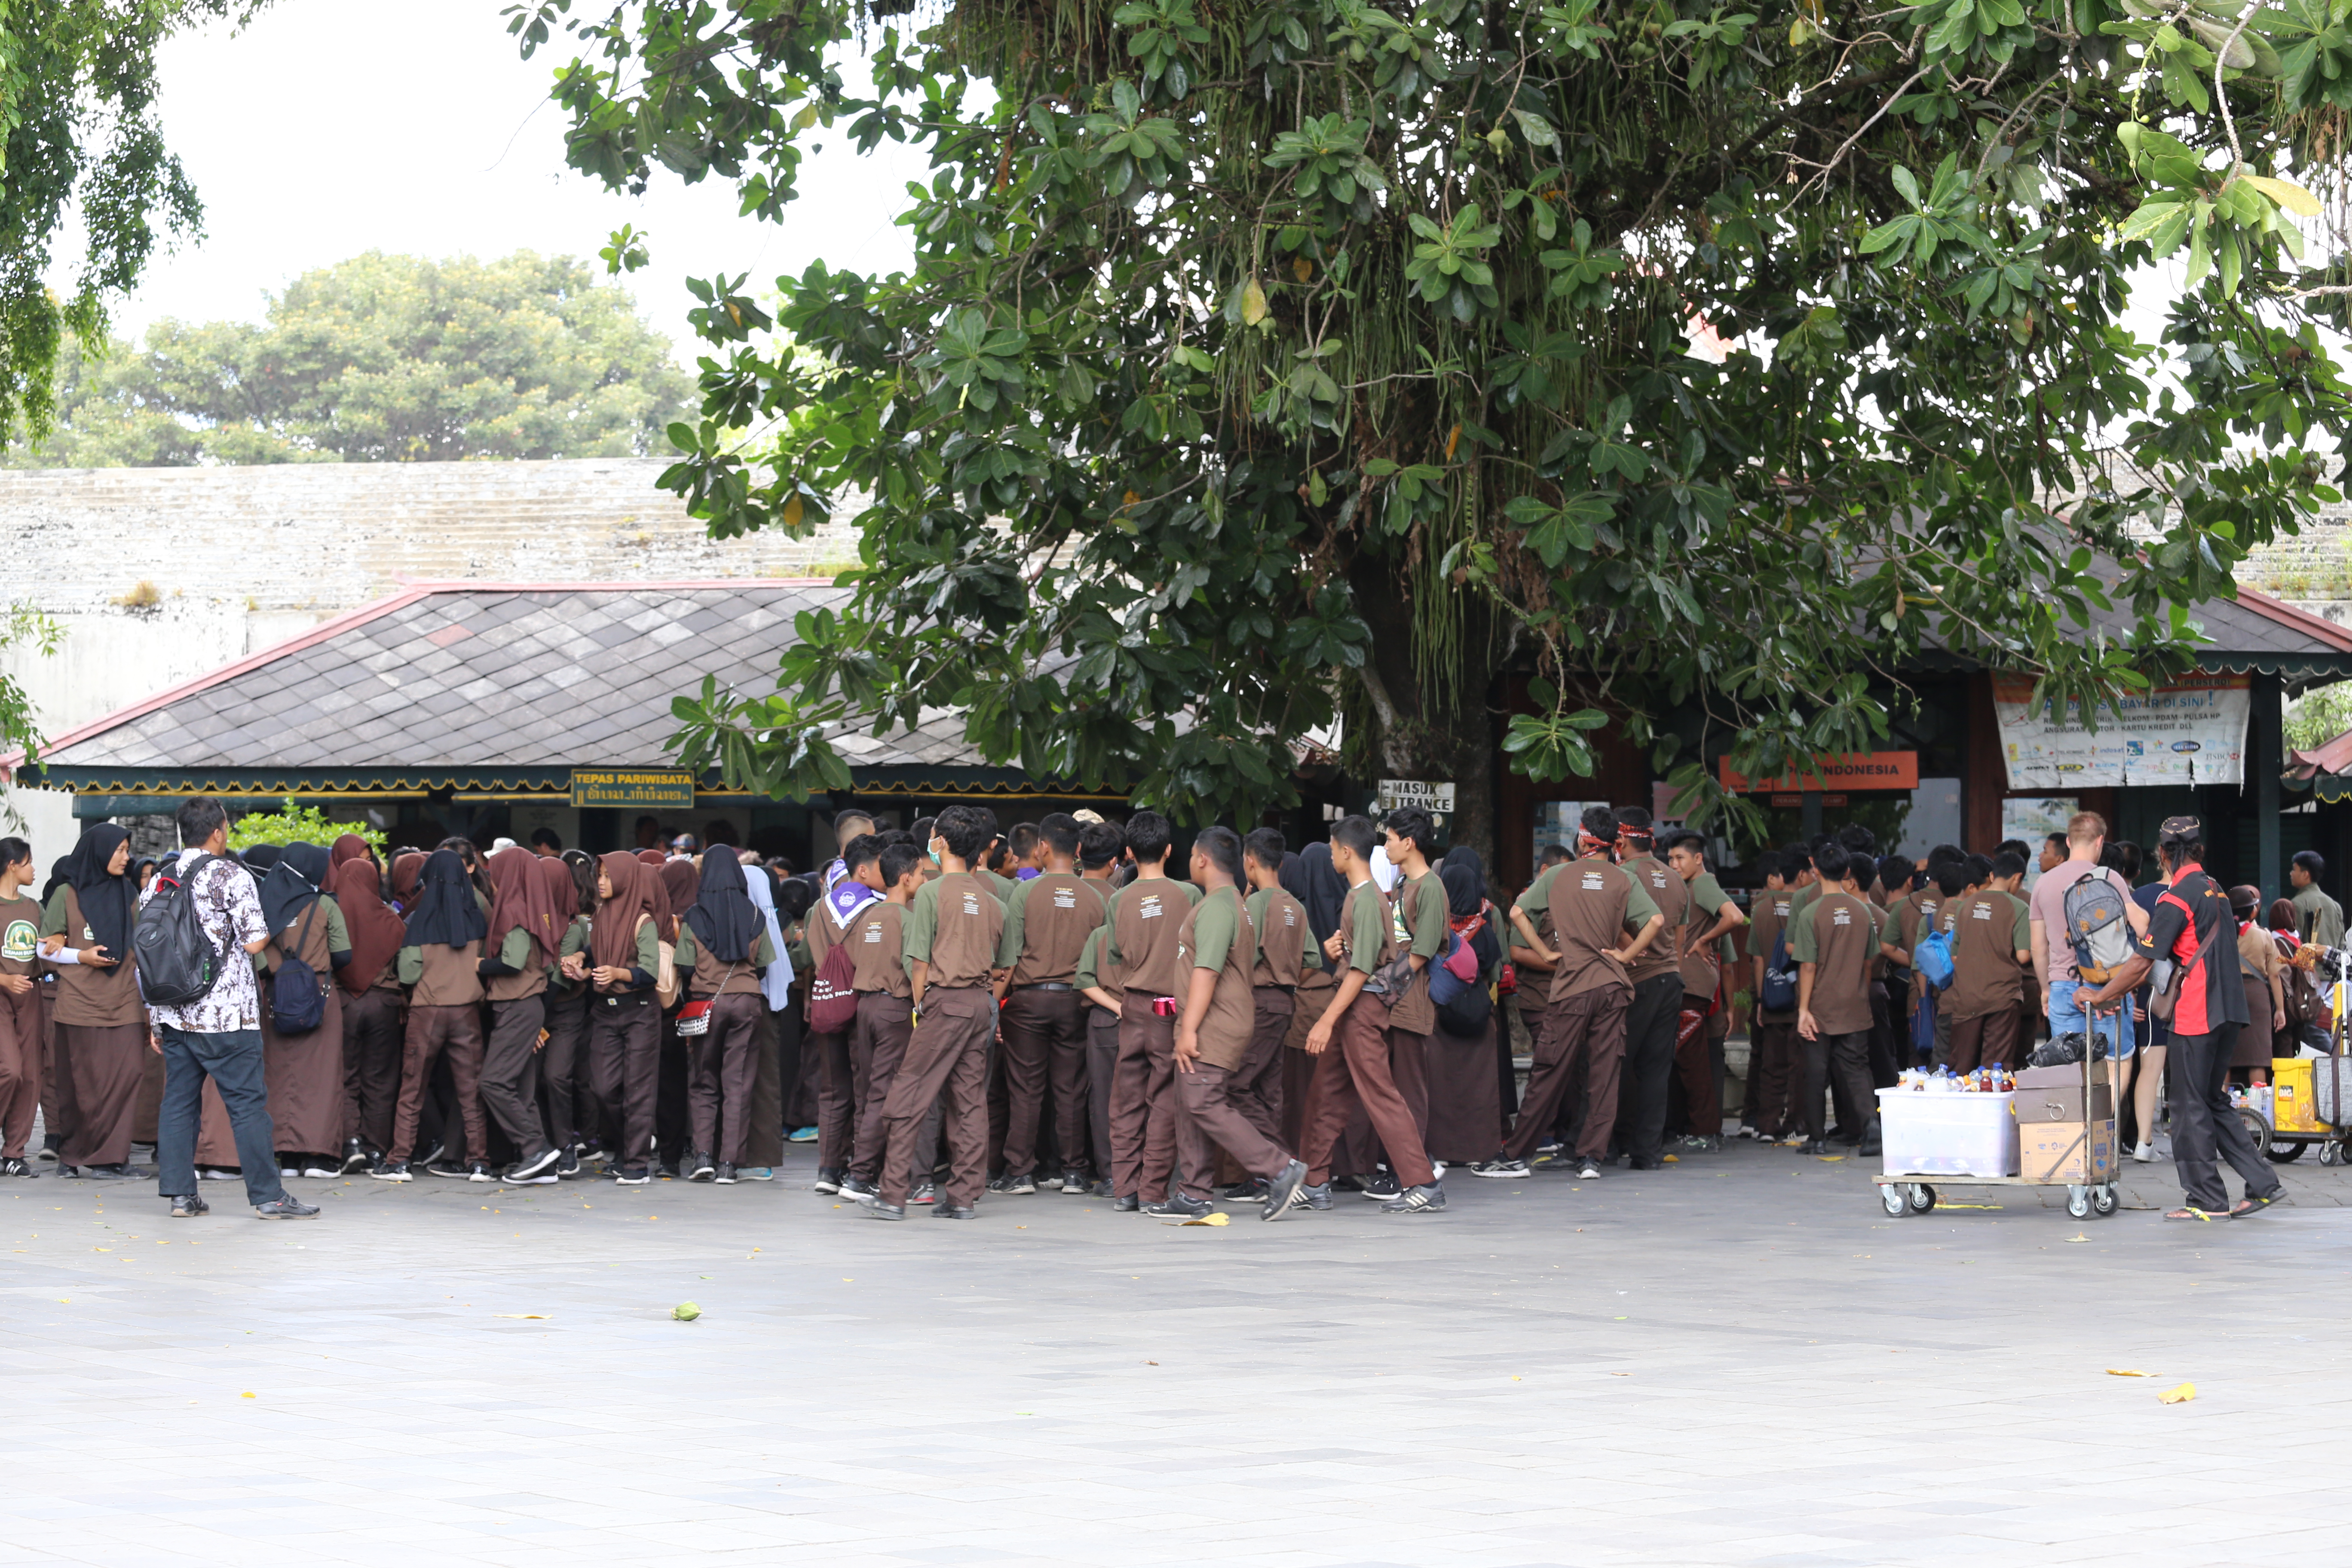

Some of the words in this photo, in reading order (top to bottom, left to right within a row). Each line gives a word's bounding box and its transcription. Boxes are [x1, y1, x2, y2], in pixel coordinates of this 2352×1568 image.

[2181, 678, 2230, 687] (PERSERO)
[2044, 697, 2079, 710] ADA
[2119, 698, 2159, 709] BAYR
[2164, 698, 2175, 708] DI
[2179, 697, 2204, 707] SINI
[575, 774, 614, 784] TEPAS
[617, 774, 692, 784] PARIWISATA
[1393, 782, 1437, 795] MASUK
